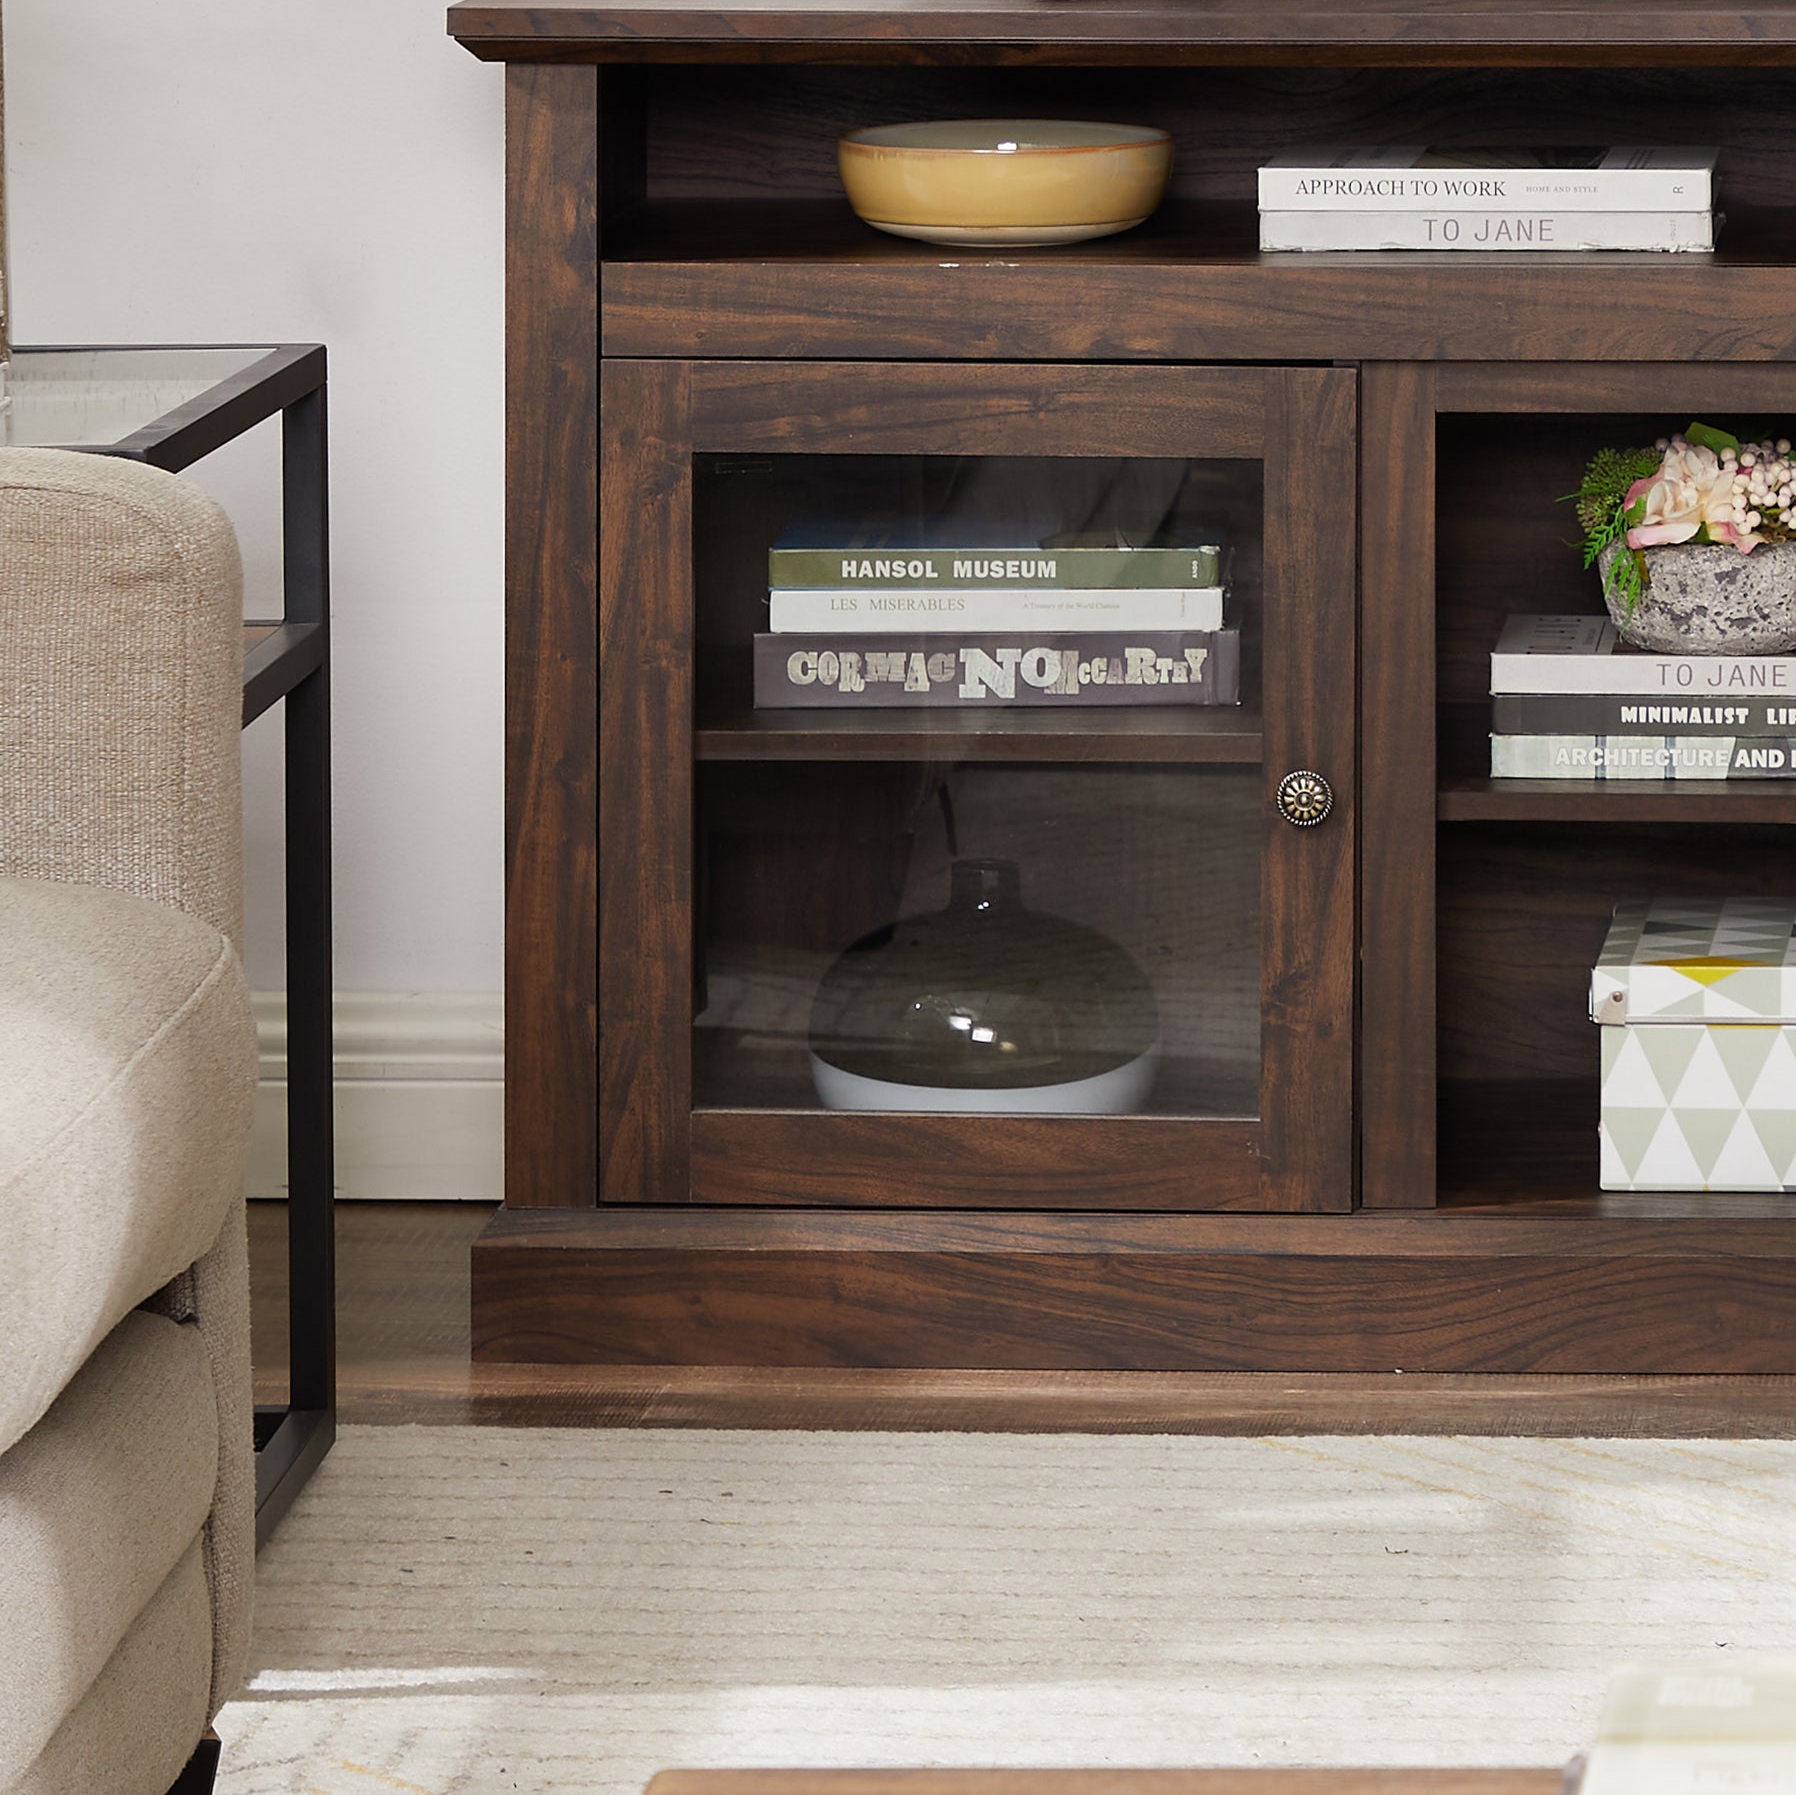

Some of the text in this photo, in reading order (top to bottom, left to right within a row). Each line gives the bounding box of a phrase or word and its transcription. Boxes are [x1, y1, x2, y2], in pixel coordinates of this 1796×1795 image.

[1295, 178, 1507, 198] APPROACH TO WORK
[1525, 185, 1599, 194] HOME AND STYLE
[1422, 218, 1555, 243] TO JANE
[841, 560, 1057, 579] HANSOL MUSEUM
[830, 597, 966, 612] LES MISERABLES
[787, 651, 957, 692] CORMAC
[958, 647, 1062, 698] NO
[1655, 663, 1788, 688] TO JANE
[1620, 706, 1749, 725] MINIMALIST
[1554, 747, 1730, 767] ARCHITECTURE
[1734, 748, 1785, 769] AND
